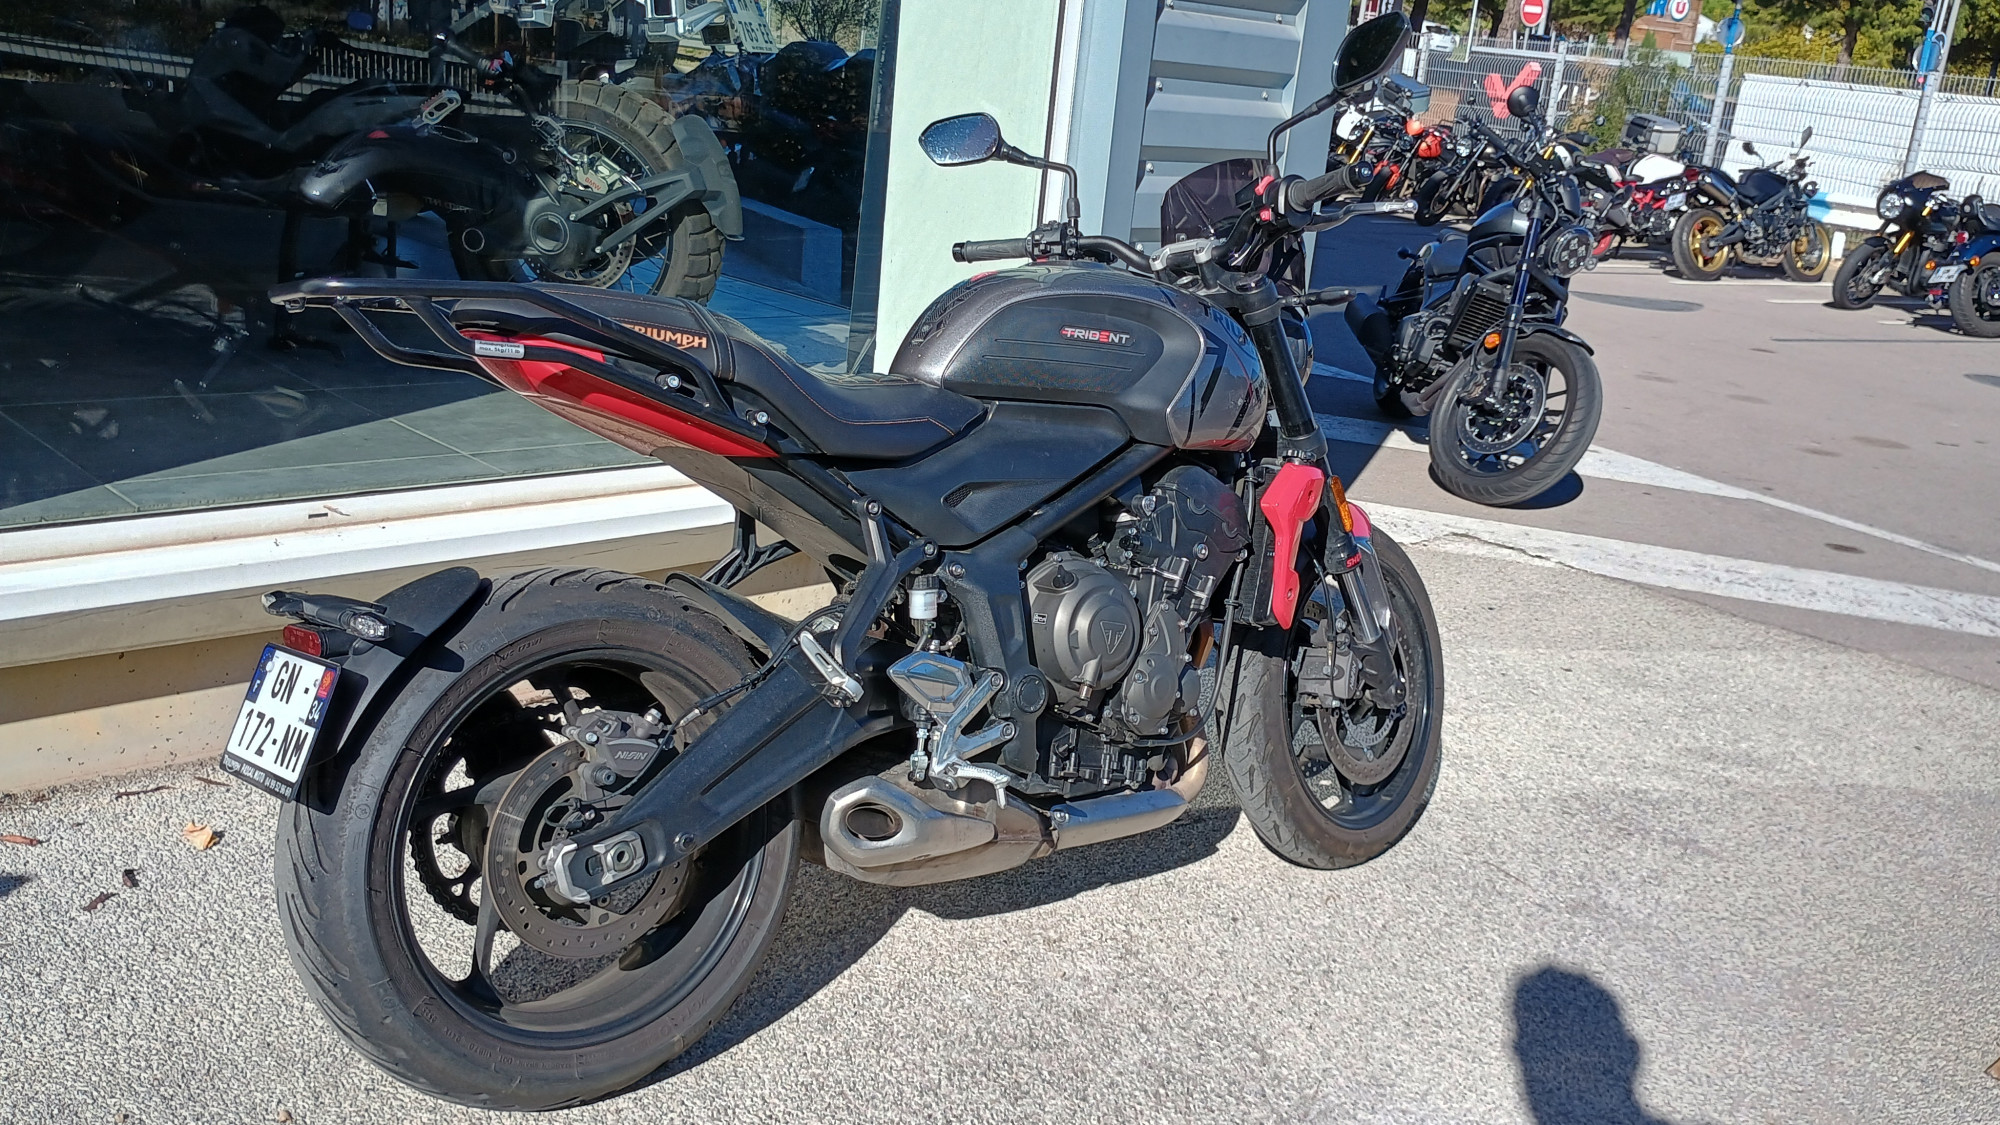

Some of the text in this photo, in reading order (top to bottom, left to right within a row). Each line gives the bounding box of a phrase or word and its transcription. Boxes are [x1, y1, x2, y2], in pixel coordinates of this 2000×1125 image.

[585, 176, 601, 191] BMW
[621, 323, 708, 350] RIUMPH
[1062, 327, 1130, 345] TRIDENT
[308, 700, 324, 723] 34
[238, 708, 309, 773] 172-NM
